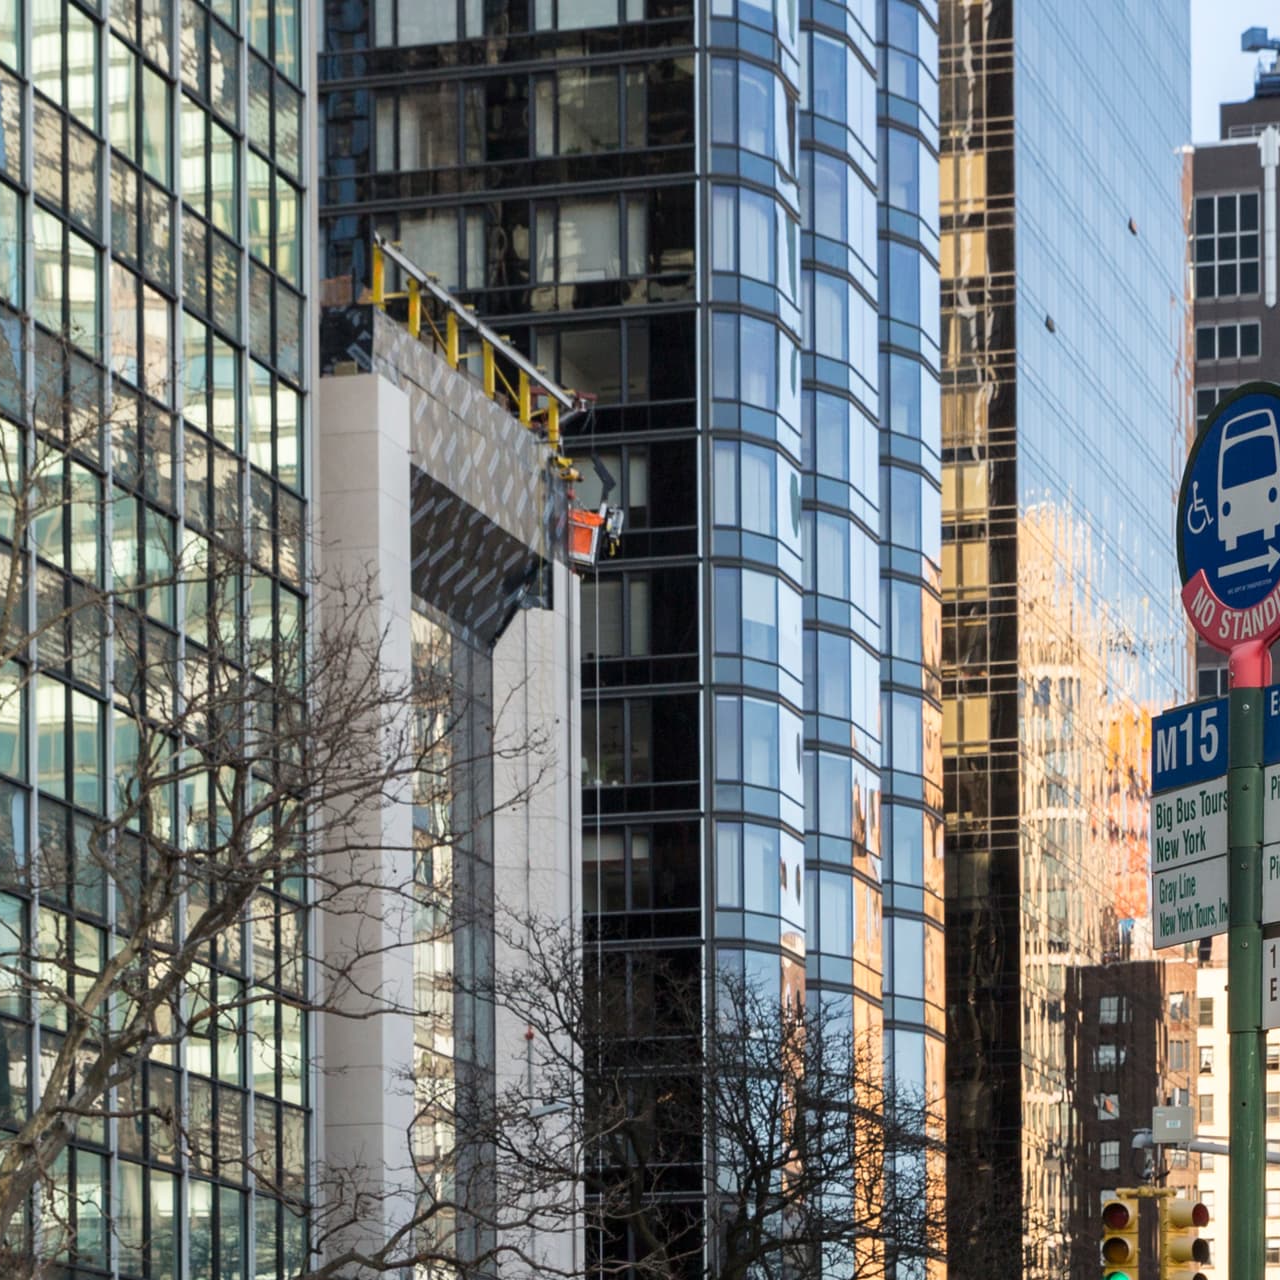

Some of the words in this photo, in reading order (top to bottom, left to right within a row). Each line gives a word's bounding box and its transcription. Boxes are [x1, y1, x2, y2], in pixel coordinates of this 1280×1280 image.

[1190, 586, 1216, 628] NO
[1156, 707, 1219, 774] M15
[1156, 801, 1173, 832] Big
[1176, 798, 1196, 824] Bus
[1199, 790, 1228, 817] Tours
[1156, 837, 1179, 864] New
[1183, 826, 1206, 856] York
[1160, 878, 1177, 907] Gray
[1179, 873, 1196, 899] Line
[1160, 912, 1176, 937] New
[1177, 905, 1193, 933] York
[1270, 944, 1277, 969] 1
[1270, 977, 1277, 1002] E
